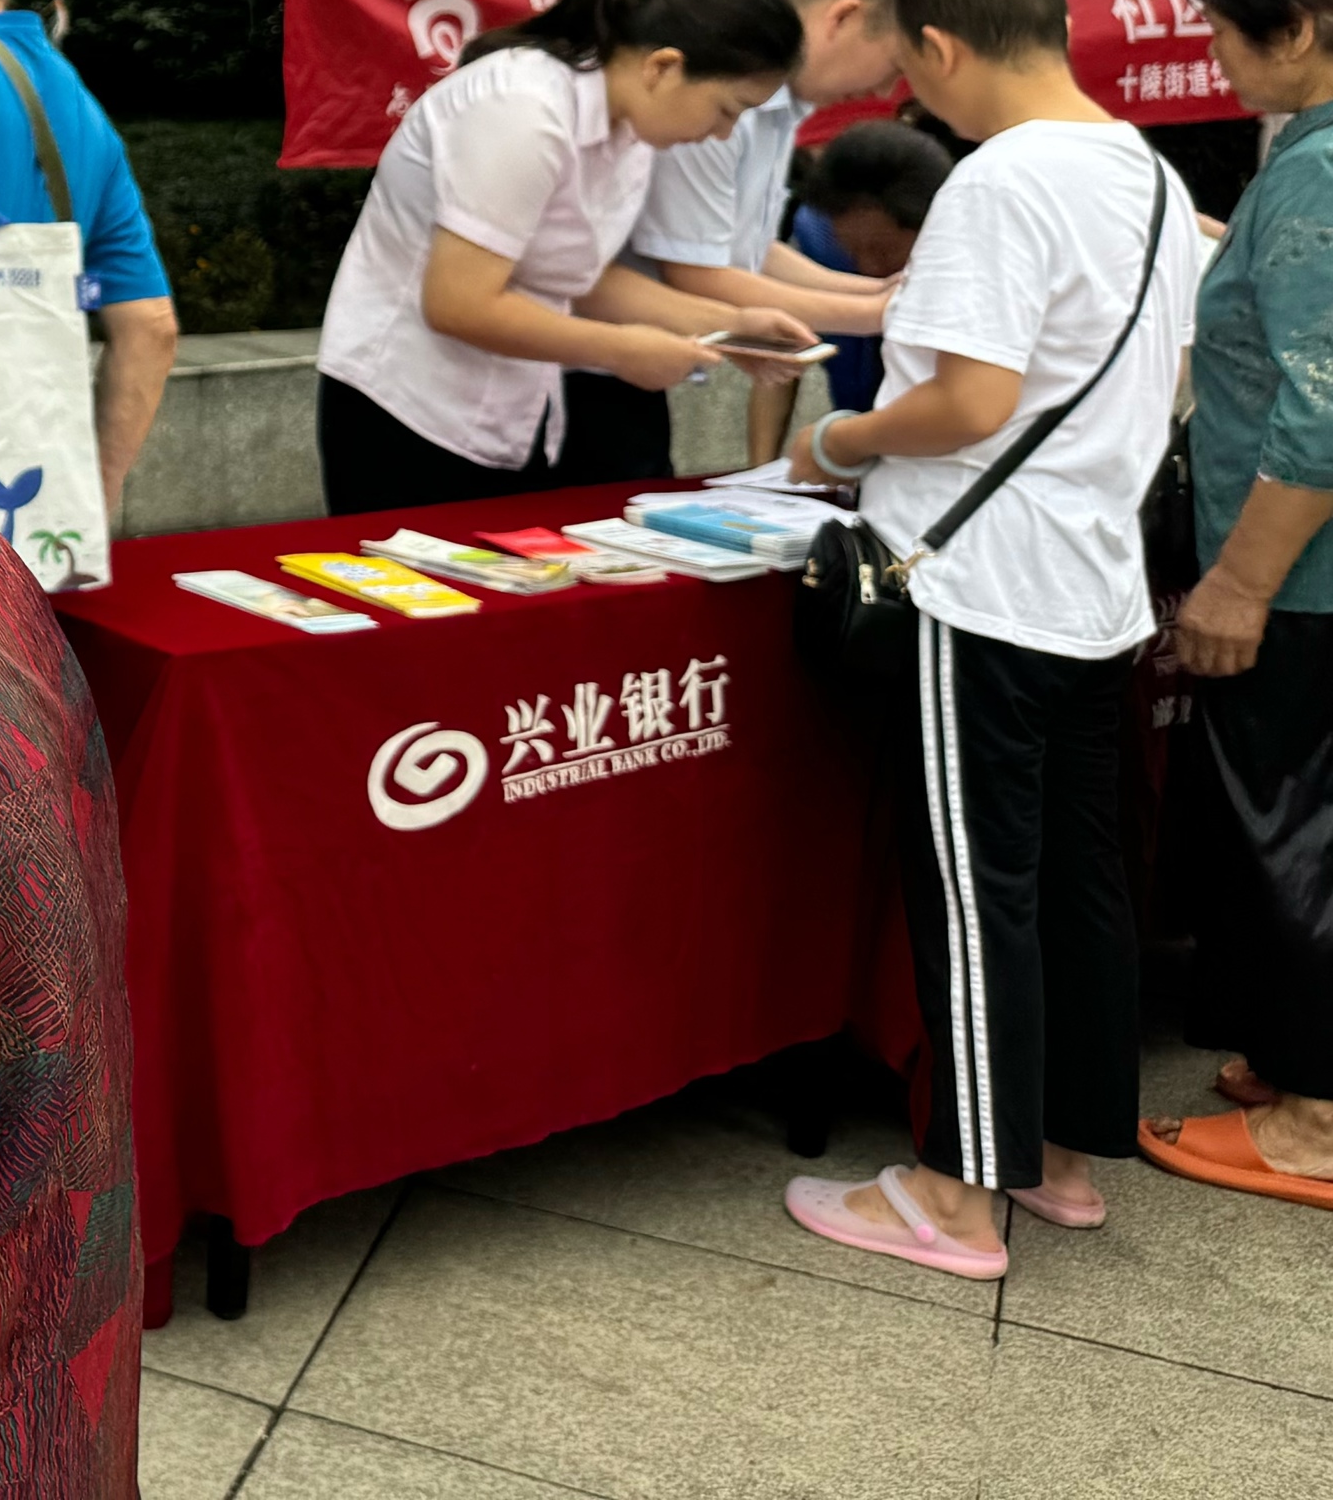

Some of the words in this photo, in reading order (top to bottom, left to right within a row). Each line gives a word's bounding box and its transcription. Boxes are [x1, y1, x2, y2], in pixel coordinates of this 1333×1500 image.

[499, 654, 731, 776] 兴业银行
[503, 763, 611, 804] INDUSTRIAL
[611, 746, 659, 776] BANK
